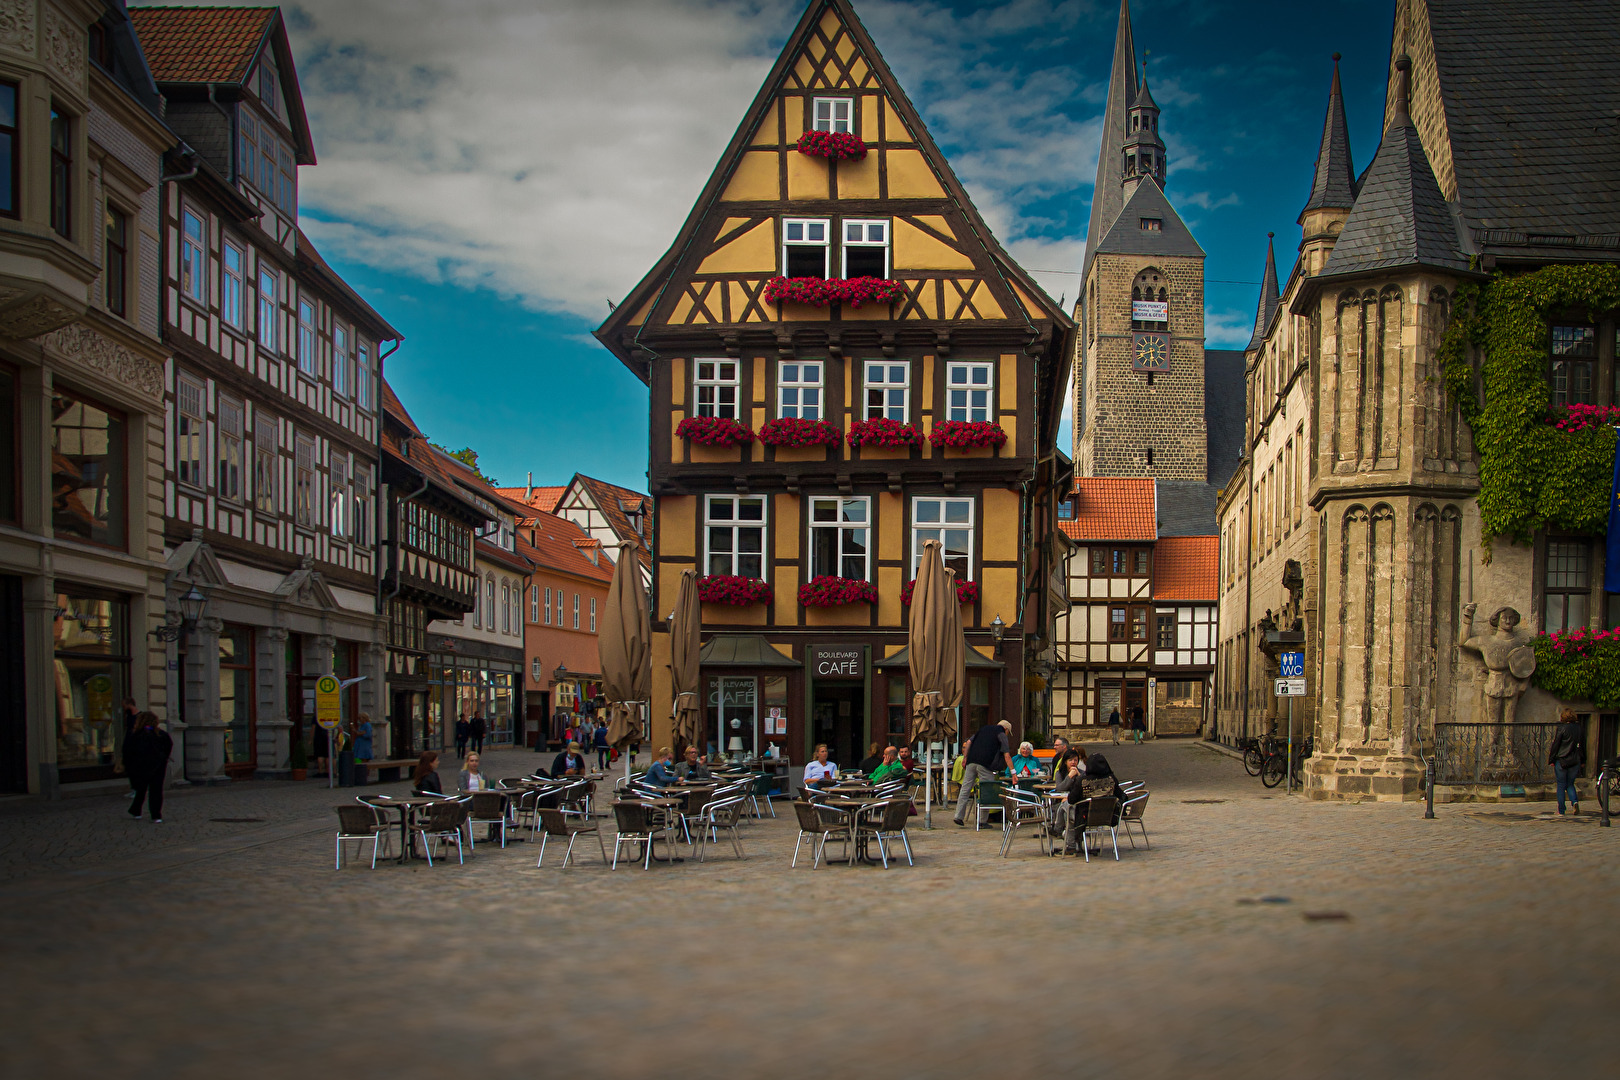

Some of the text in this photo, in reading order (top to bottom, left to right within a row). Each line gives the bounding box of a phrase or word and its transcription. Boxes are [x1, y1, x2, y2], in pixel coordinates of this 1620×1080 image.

[818, 659, 858, 675] CAFÉ
[1283, 665, 1302, 675] WC
[710, 688, 754, 704] CAFÉ
